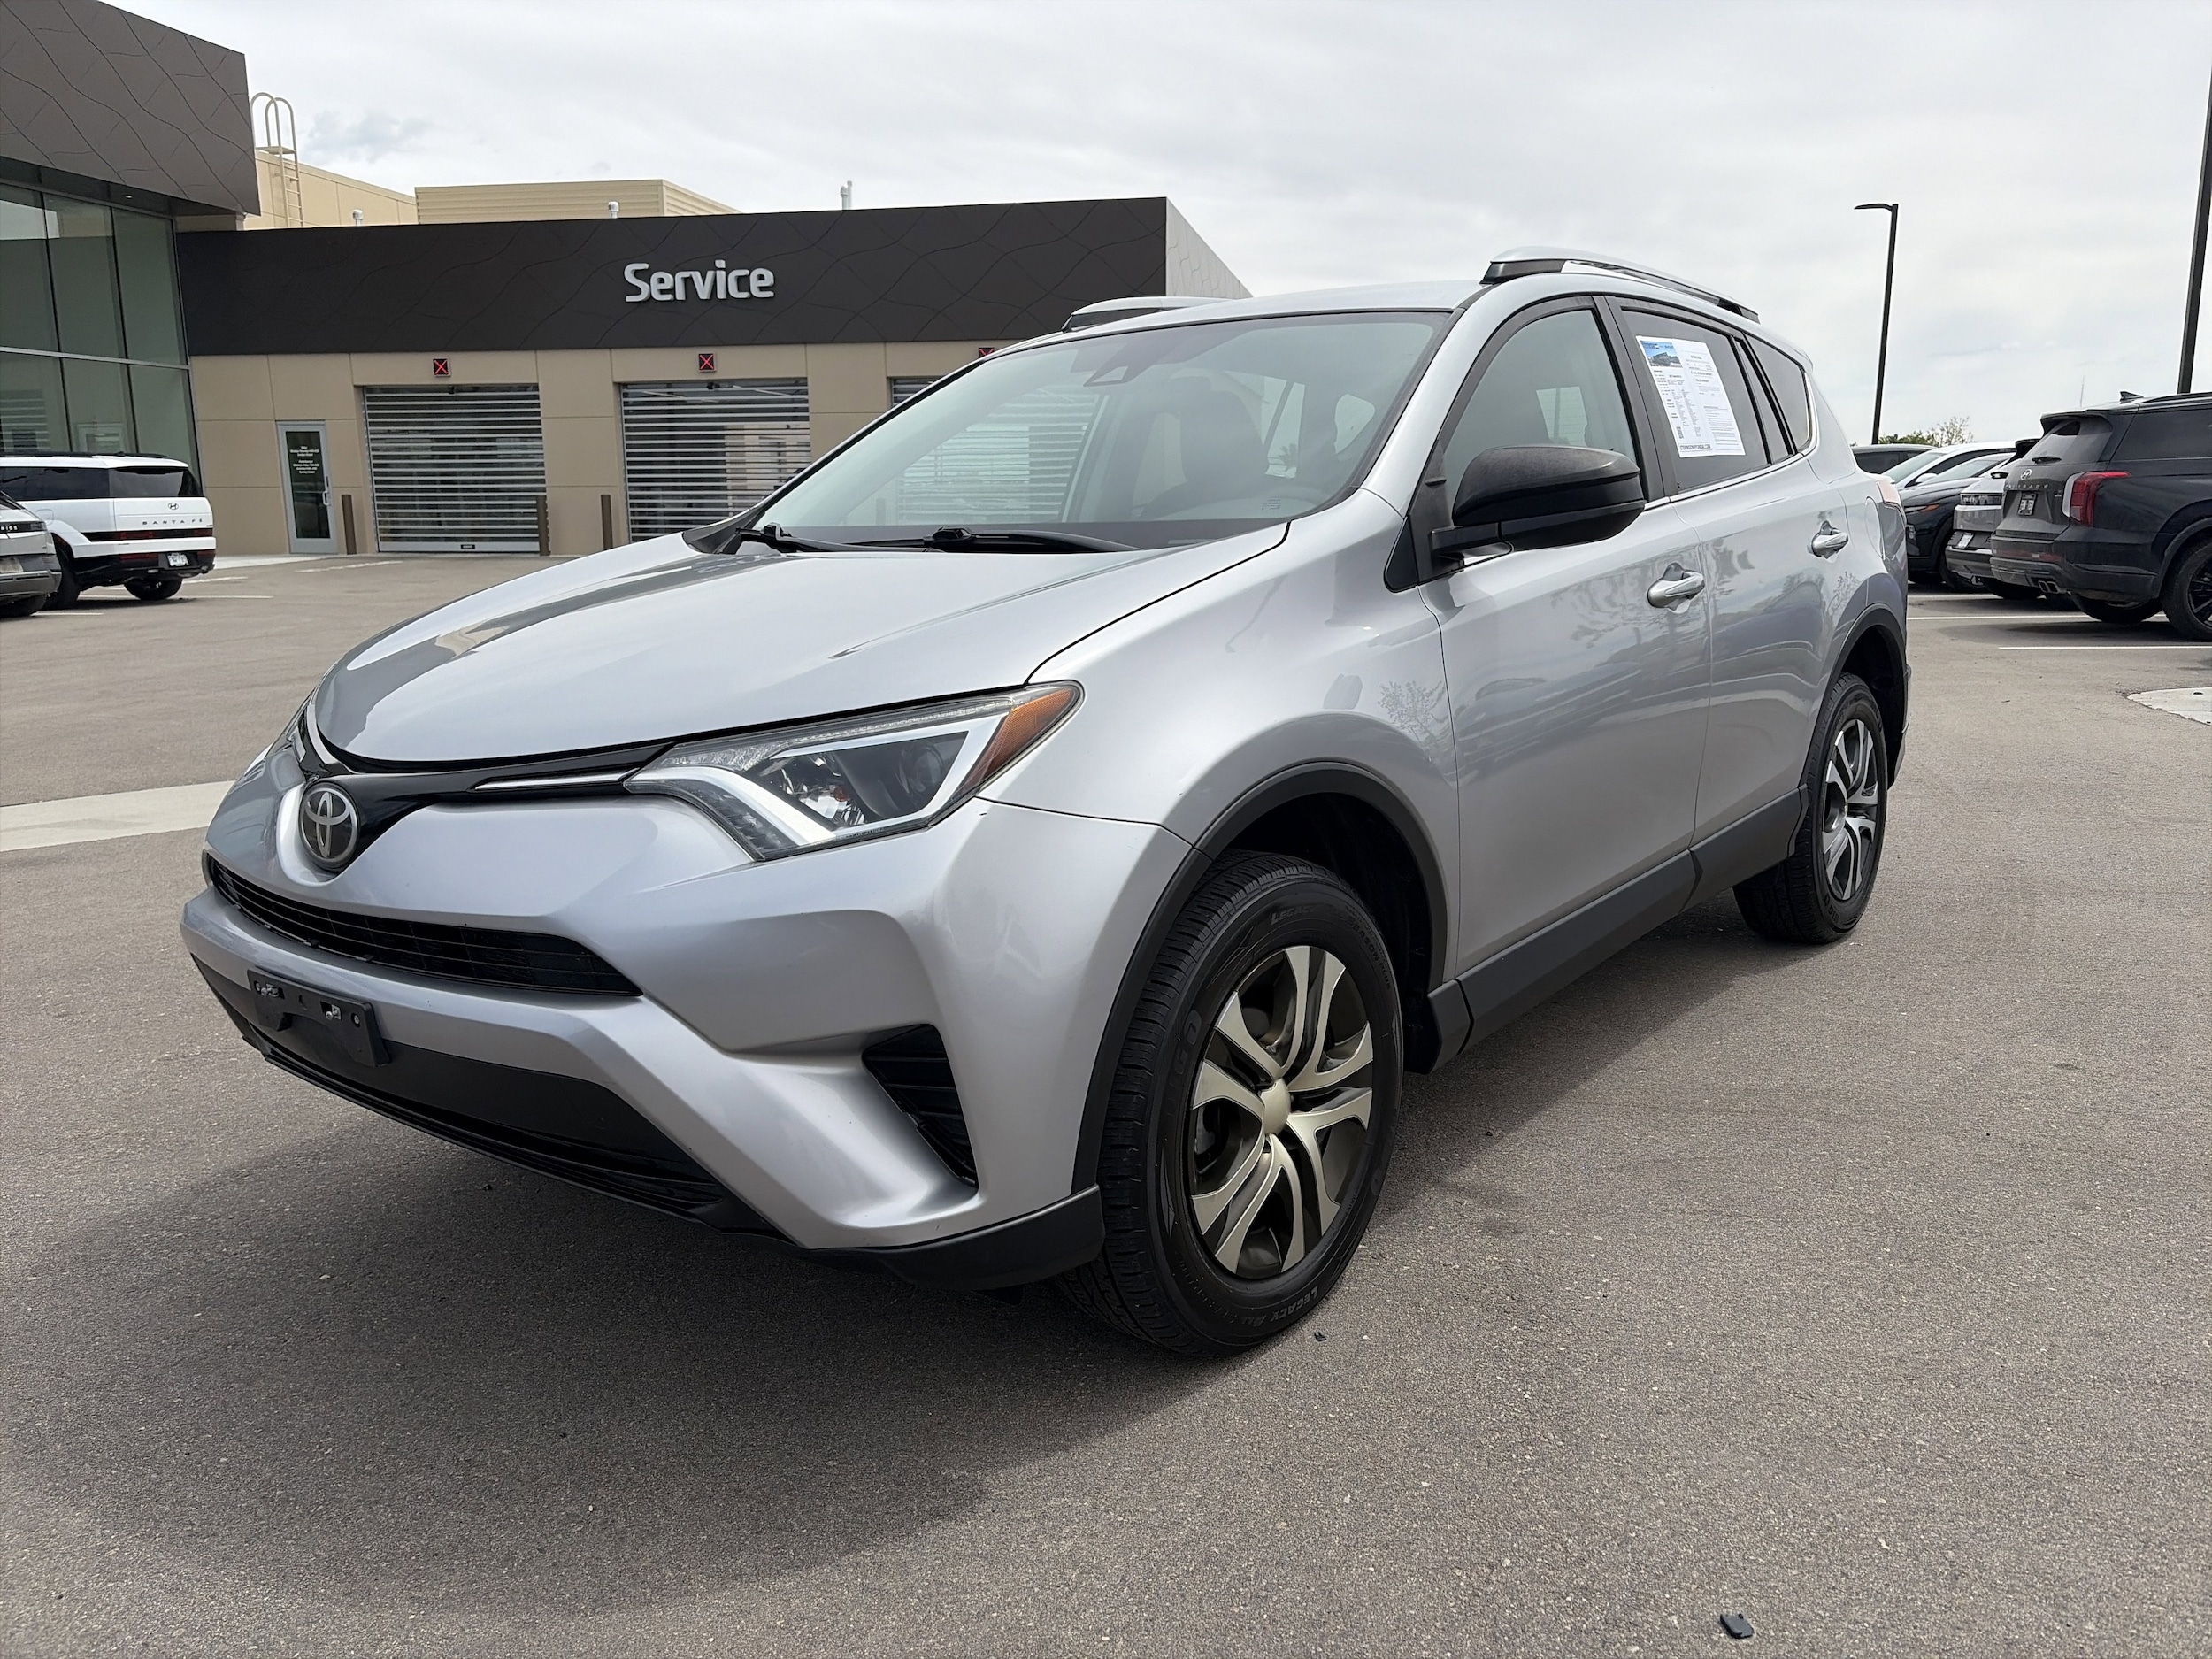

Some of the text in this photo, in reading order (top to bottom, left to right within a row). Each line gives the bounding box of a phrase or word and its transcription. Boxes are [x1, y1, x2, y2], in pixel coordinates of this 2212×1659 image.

[623, 259, 775, 303] Service
[1271, 905, 1316, 925] LEGAC
[1270, 1285, 1319, 1323] LEGACY
